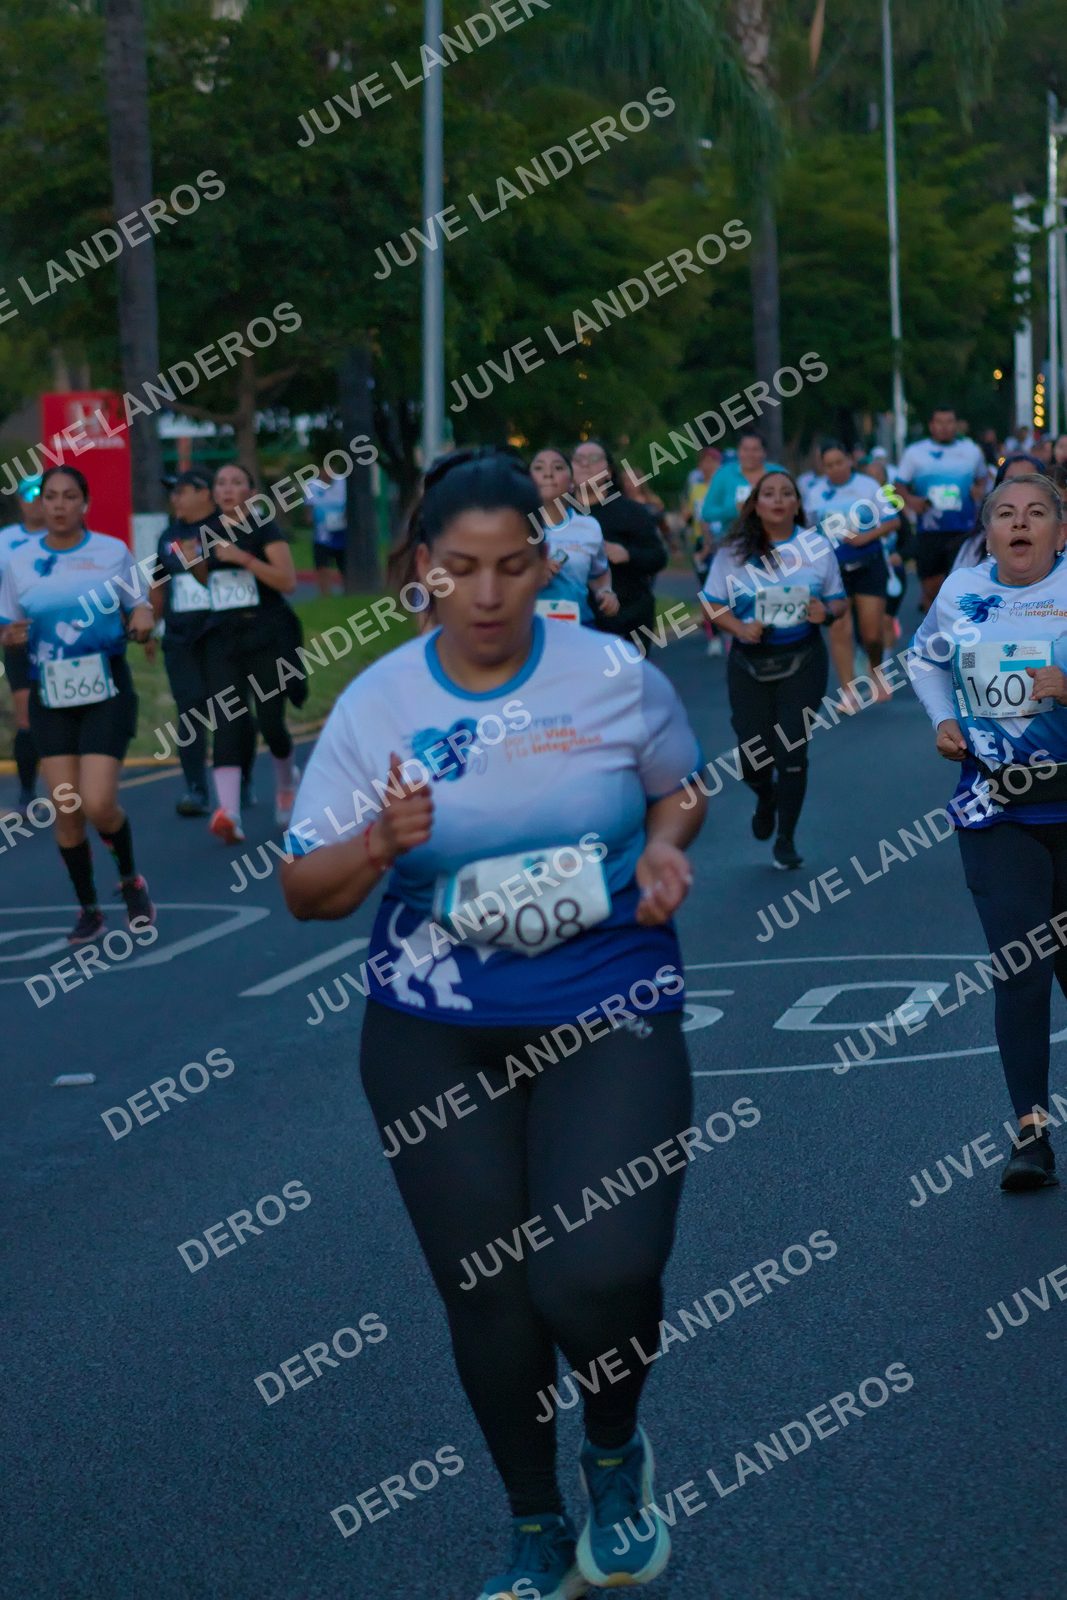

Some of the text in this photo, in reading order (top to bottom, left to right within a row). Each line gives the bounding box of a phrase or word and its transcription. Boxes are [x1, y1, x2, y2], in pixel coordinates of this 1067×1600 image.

[215, 583, 256, 603] 1709
[760, 600, 807, 623] 1793
[50, 673, 105, 701] 1566
[967, 673, 1042, 708] 160
